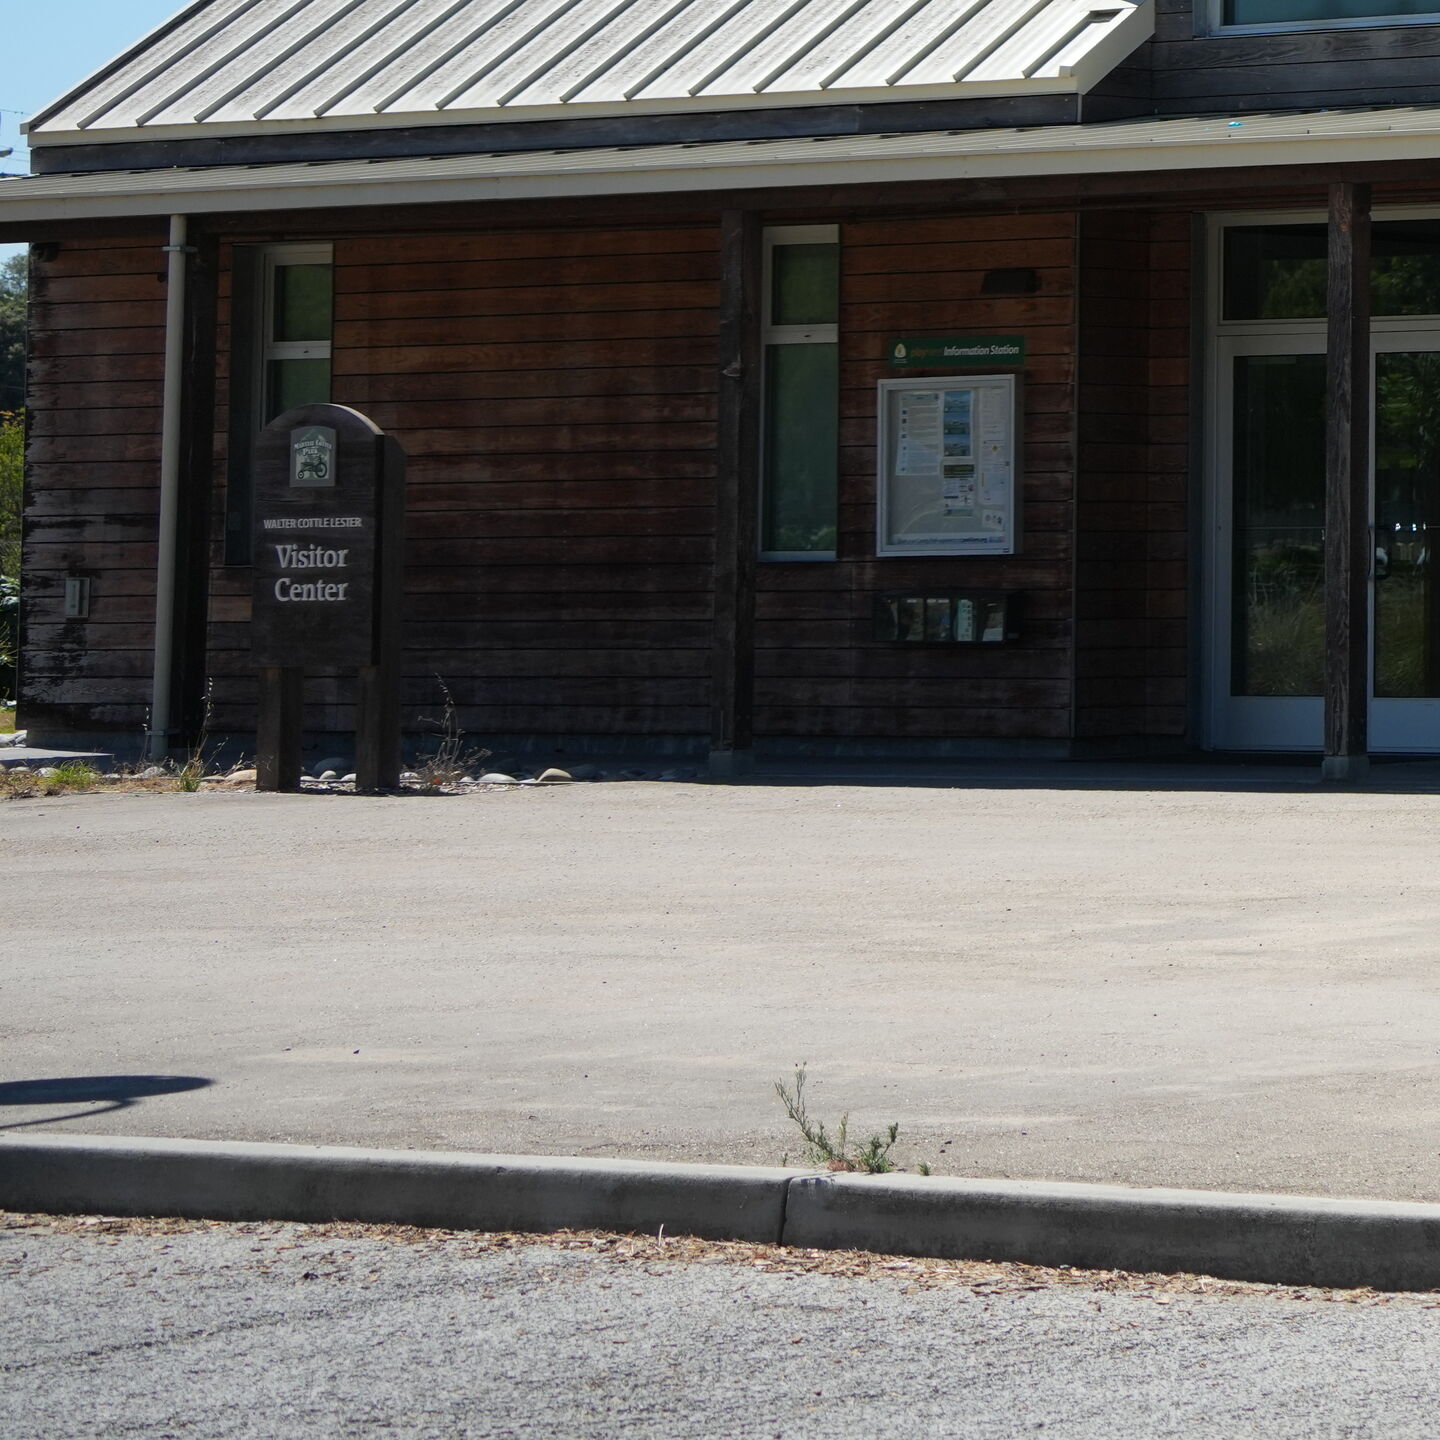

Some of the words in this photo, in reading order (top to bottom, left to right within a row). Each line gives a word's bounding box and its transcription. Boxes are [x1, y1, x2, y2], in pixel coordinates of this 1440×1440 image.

[943, 345, 990, 357] Information
[990, 344, 1020, 355] Station
[263, 518, 297, 529] WALTER
[297, 517, 331, 528] COTTLE
[331, 517, 363, 528] LESTER
[275, 544, 350, 568] Visitor
[274, 577, 349, 601] Center
